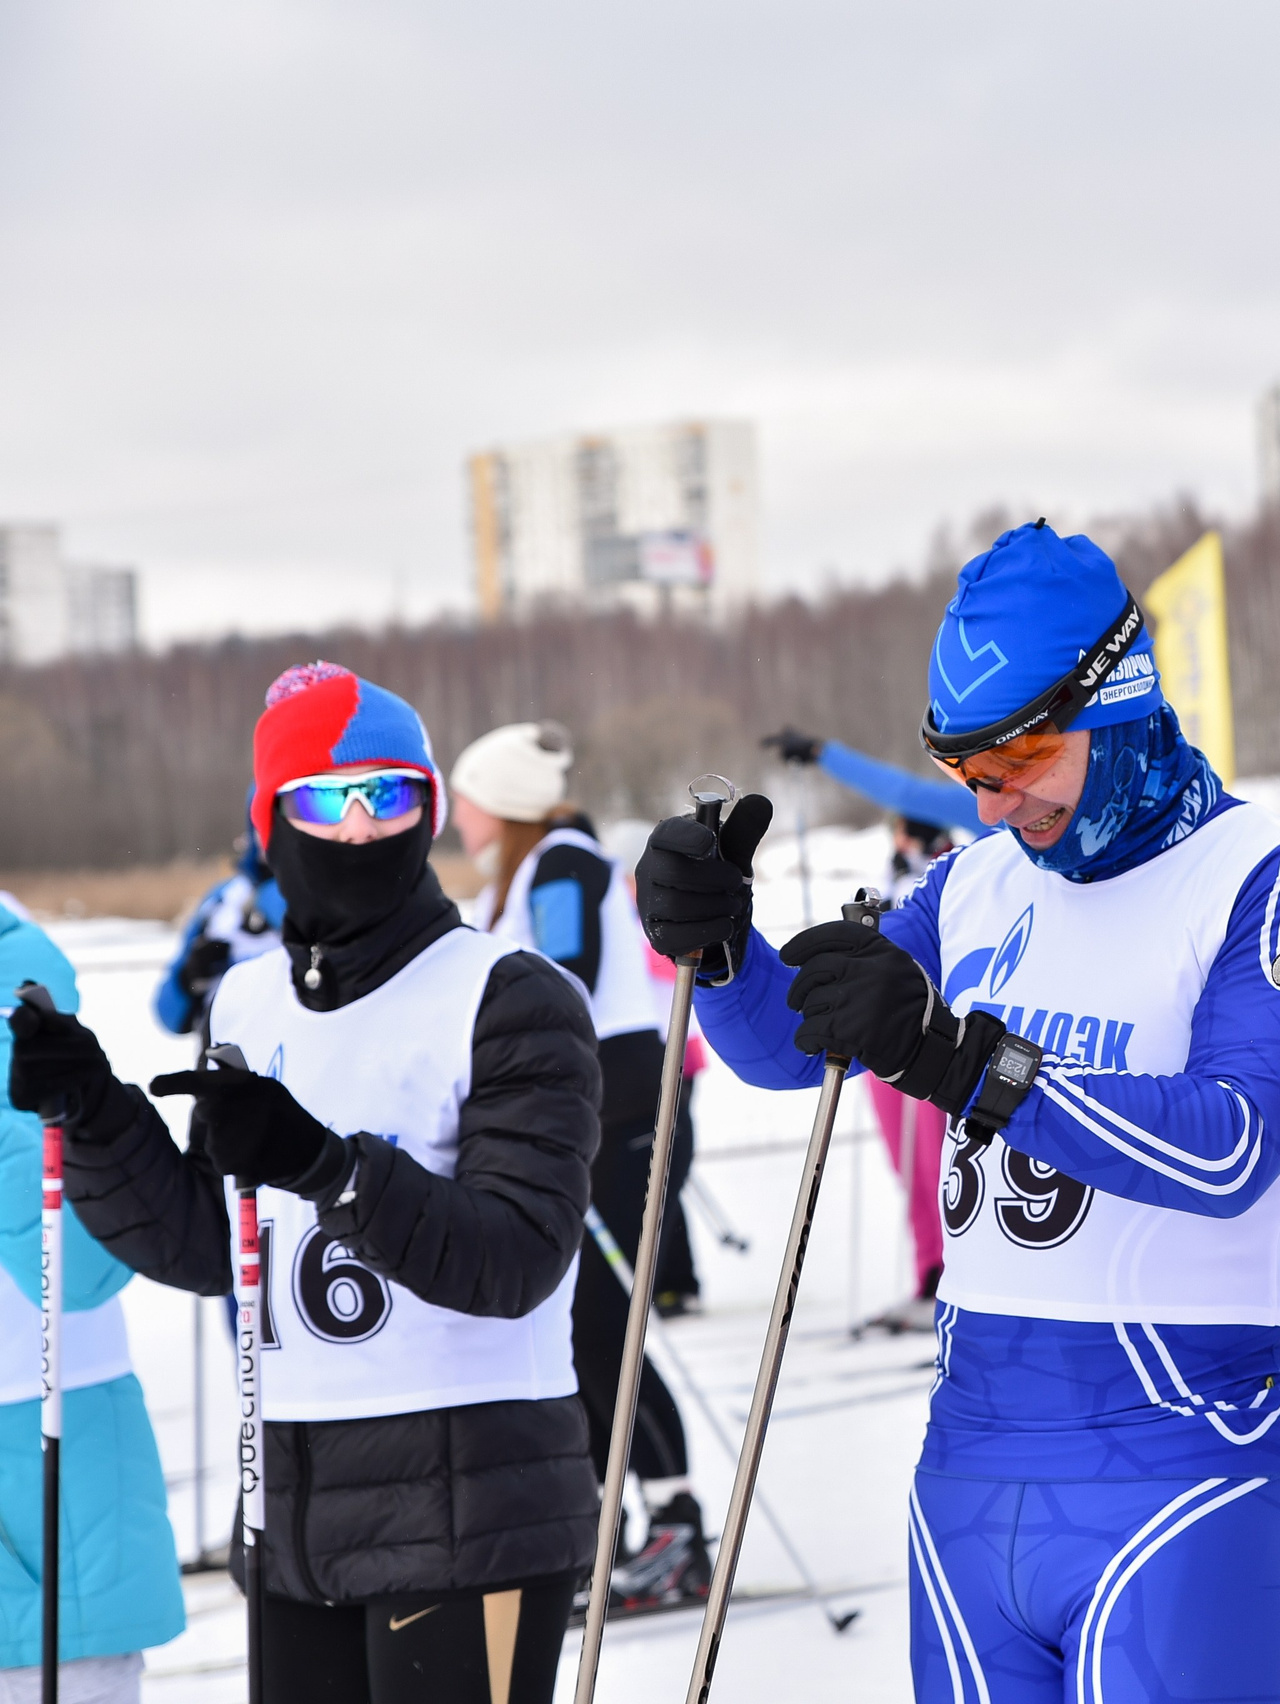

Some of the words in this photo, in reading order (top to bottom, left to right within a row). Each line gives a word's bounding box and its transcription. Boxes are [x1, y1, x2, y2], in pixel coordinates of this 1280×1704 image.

[1106, 605, 1140, 652] WAY
[996, 726, 1024, 744] ONE
[1023, 709, 1049, 728] WAY
[1000, 1056, 1027, 1076] 12:33
[943, 1108, 1095, 1250] 39
